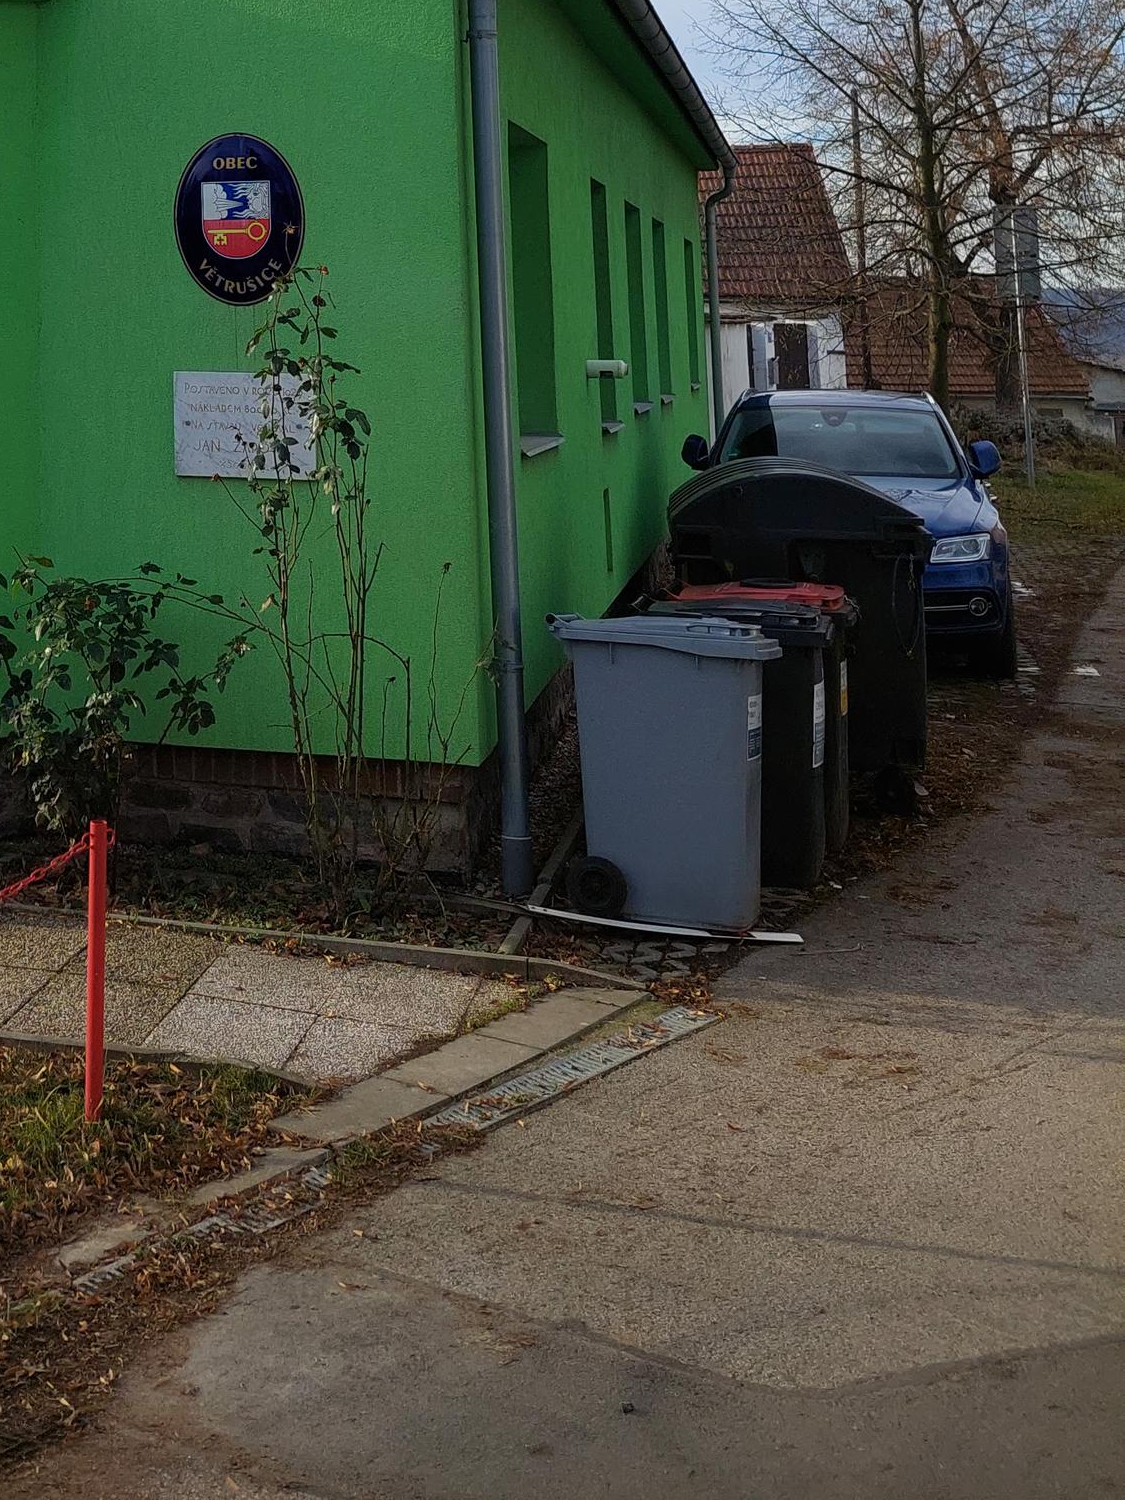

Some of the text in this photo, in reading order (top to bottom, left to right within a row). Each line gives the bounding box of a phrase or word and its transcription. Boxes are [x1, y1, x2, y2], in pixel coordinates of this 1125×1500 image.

[212, 156, 258, 170] OBEC
[198, 257, 283, 294] VĚTRUŠICE
[184, 382, 240, 395] POSTAVENO
[243, 387, 249, 396] V
[194, 439, 221, 452] JAN
